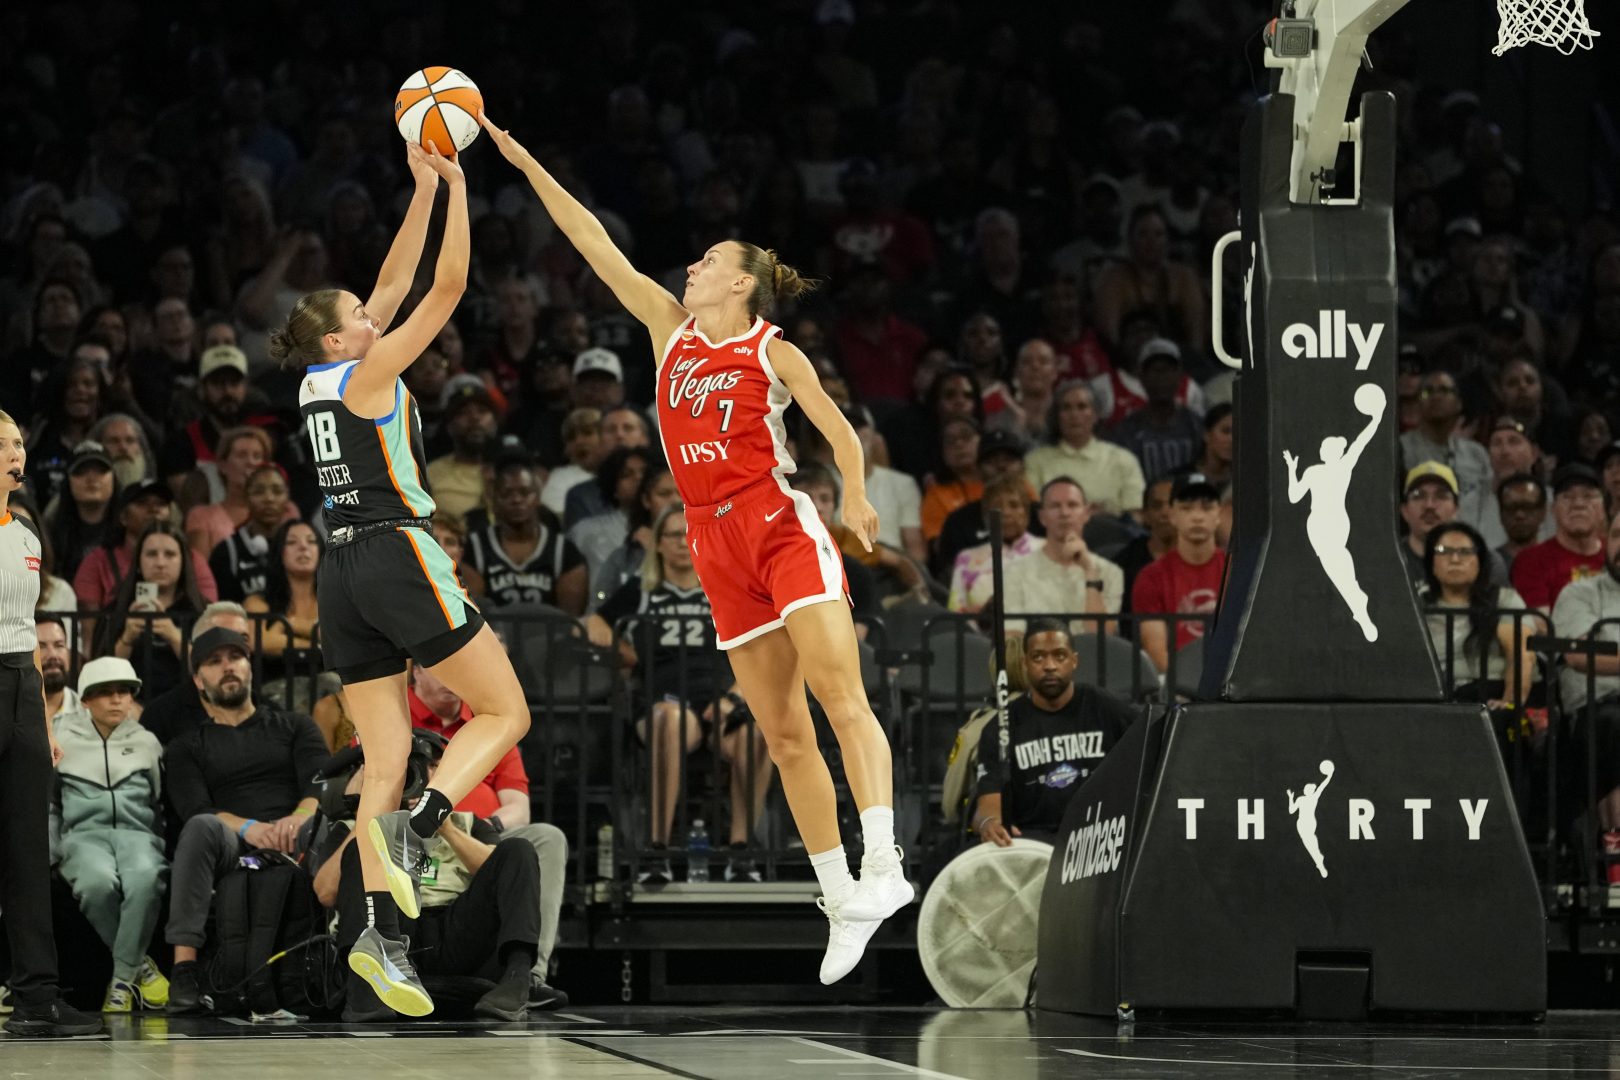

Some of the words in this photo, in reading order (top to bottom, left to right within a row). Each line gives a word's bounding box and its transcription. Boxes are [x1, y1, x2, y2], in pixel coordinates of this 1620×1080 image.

[733, 346, 754, 356] ally
[1281, 309, 1385, 371] ally
[669, 355, 697, 379] Las
[669, 358, 744, 417] Vegas
[717, 399, 735, 433] 7
[306, 410, 341, 463] 18
[679, 439, 731, 465] IPSY
[714, 502, 734, 518] Aces
[660, 619, 704, 646] 22
[997, 669, 1009, 747] ACES
[1015, 737, 1052, 770] UTAH
[1052, 731, 1105, 762] STARZZ
[1061, 801, 1126, 885] coinbase
